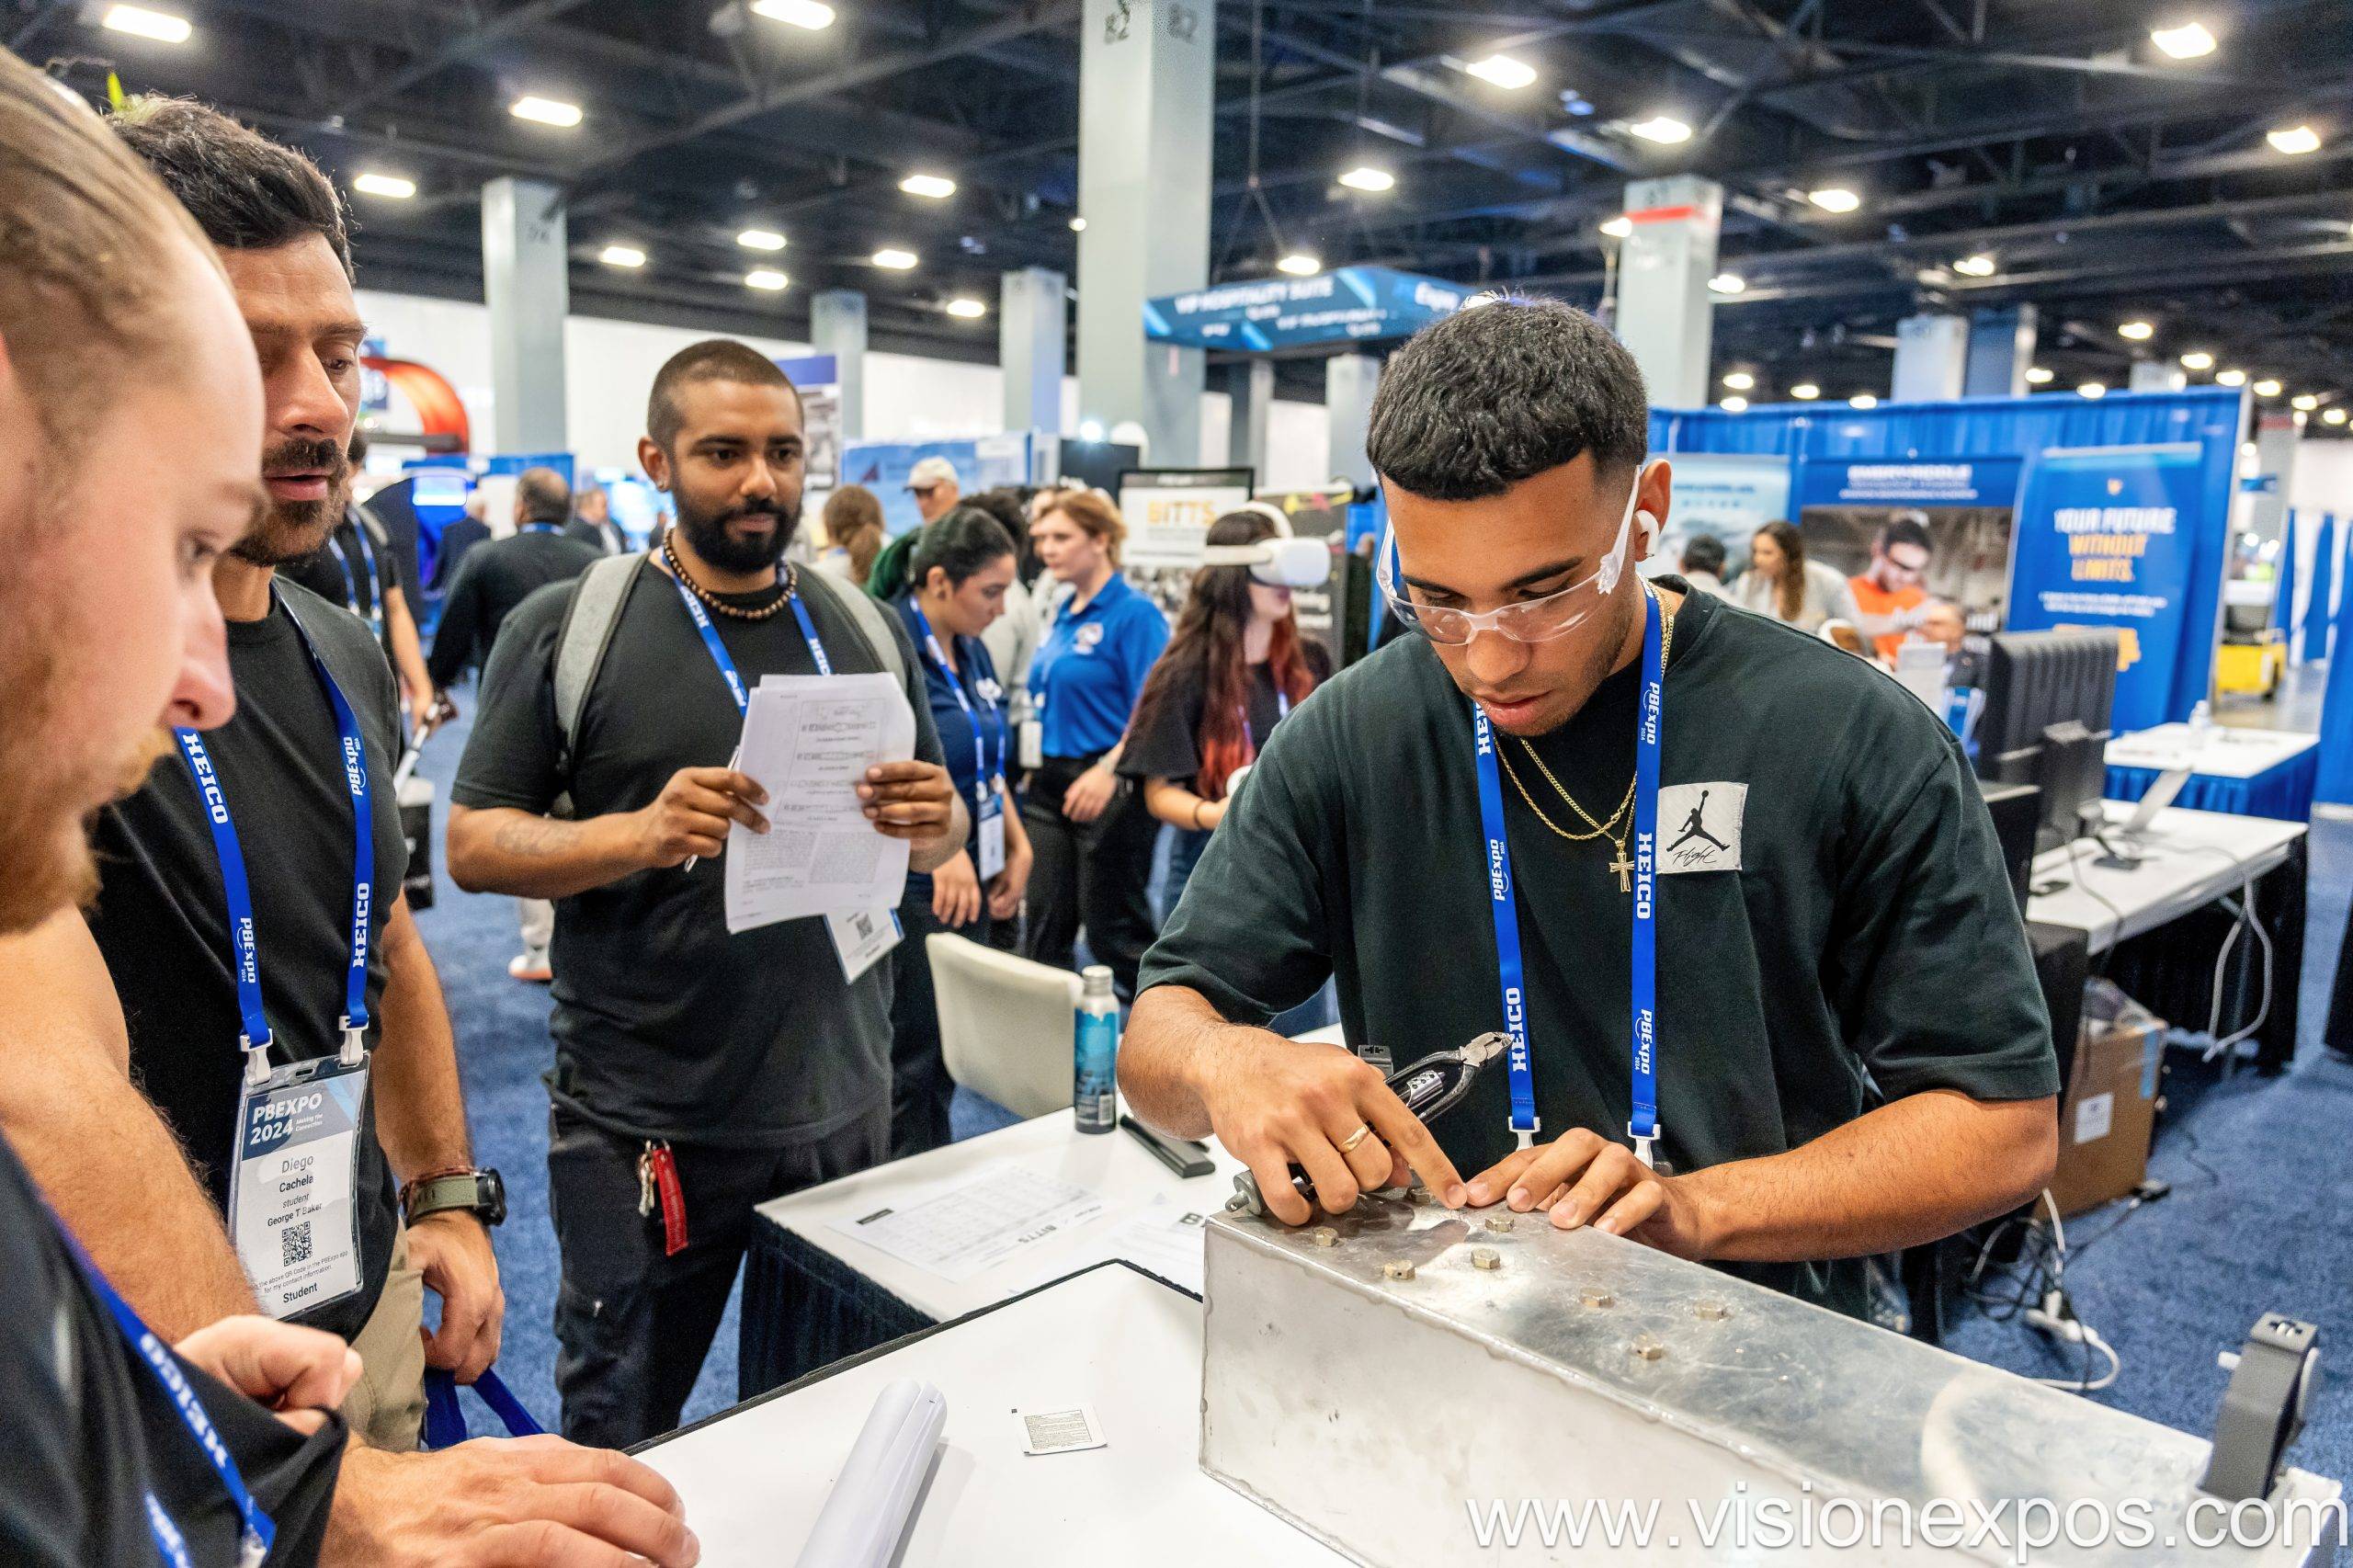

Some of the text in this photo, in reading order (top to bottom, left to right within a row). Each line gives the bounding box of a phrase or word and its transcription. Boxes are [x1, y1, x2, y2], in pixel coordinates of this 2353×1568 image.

[182, 733, 229, 824] HEICO
[1636, 832, 1653, 919] HEICO
[353, 882, 369, 968] HEICO
[1506, 987, 1528, 1072] HEICO
[253, 1093, 323, 1124] PBEXPO
[250, 1119, 294, 1145] 2024
[282, 1155, 314, 1173] Diego
[279, 1175, 313, 1192] Cachela
[282, 1193, 310, 1209] student
[267, 1203, 323, 1227] George T Baker
[283, 1282, 318, 1303] Student
